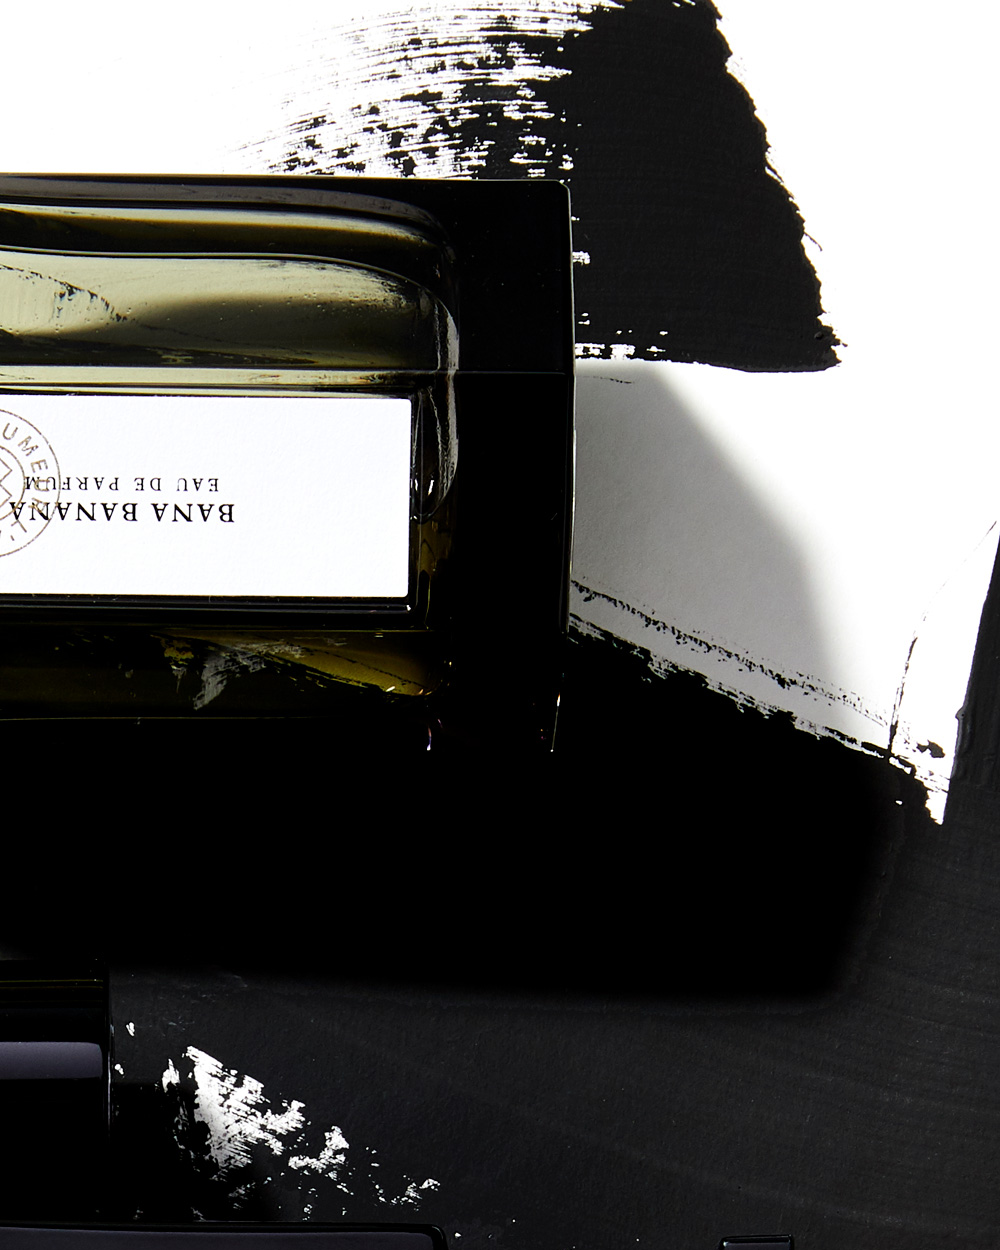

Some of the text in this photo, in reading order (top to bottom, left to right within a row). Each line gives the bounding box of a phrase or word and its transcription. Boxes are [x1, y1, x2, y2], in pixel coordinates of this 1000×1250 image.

[22, 475, 219, 494] EAU DE PARFUM
[9, 501, 235, 523] BANA BANANA
